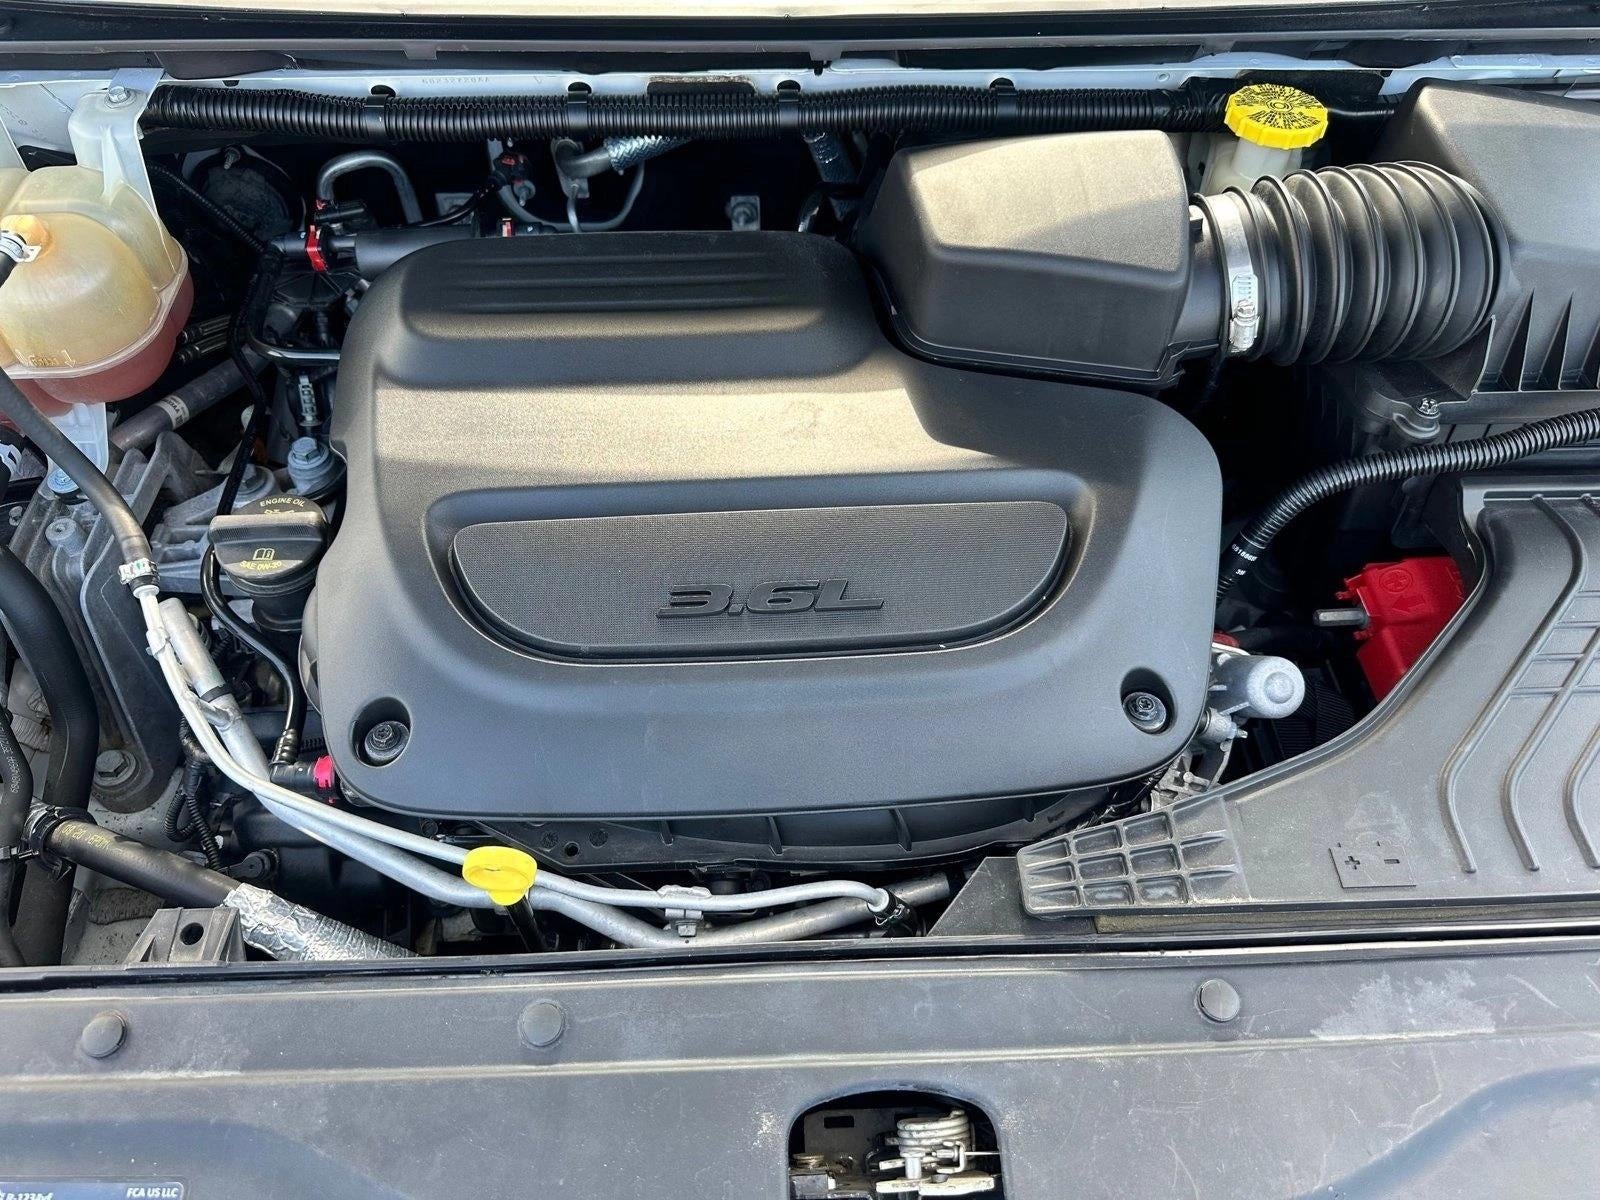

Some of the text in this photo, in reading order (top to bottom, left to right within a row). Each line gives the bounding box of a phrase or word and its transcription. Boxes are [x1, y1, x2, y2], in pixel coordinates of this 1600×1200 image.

[260, 497, 306, 508] ENGINE OIL
[239, 560, 257, 570] SAE
[656, 578, 884, 619] 3.6L
[126, 1187, 179, 1198] FCA US LLC
